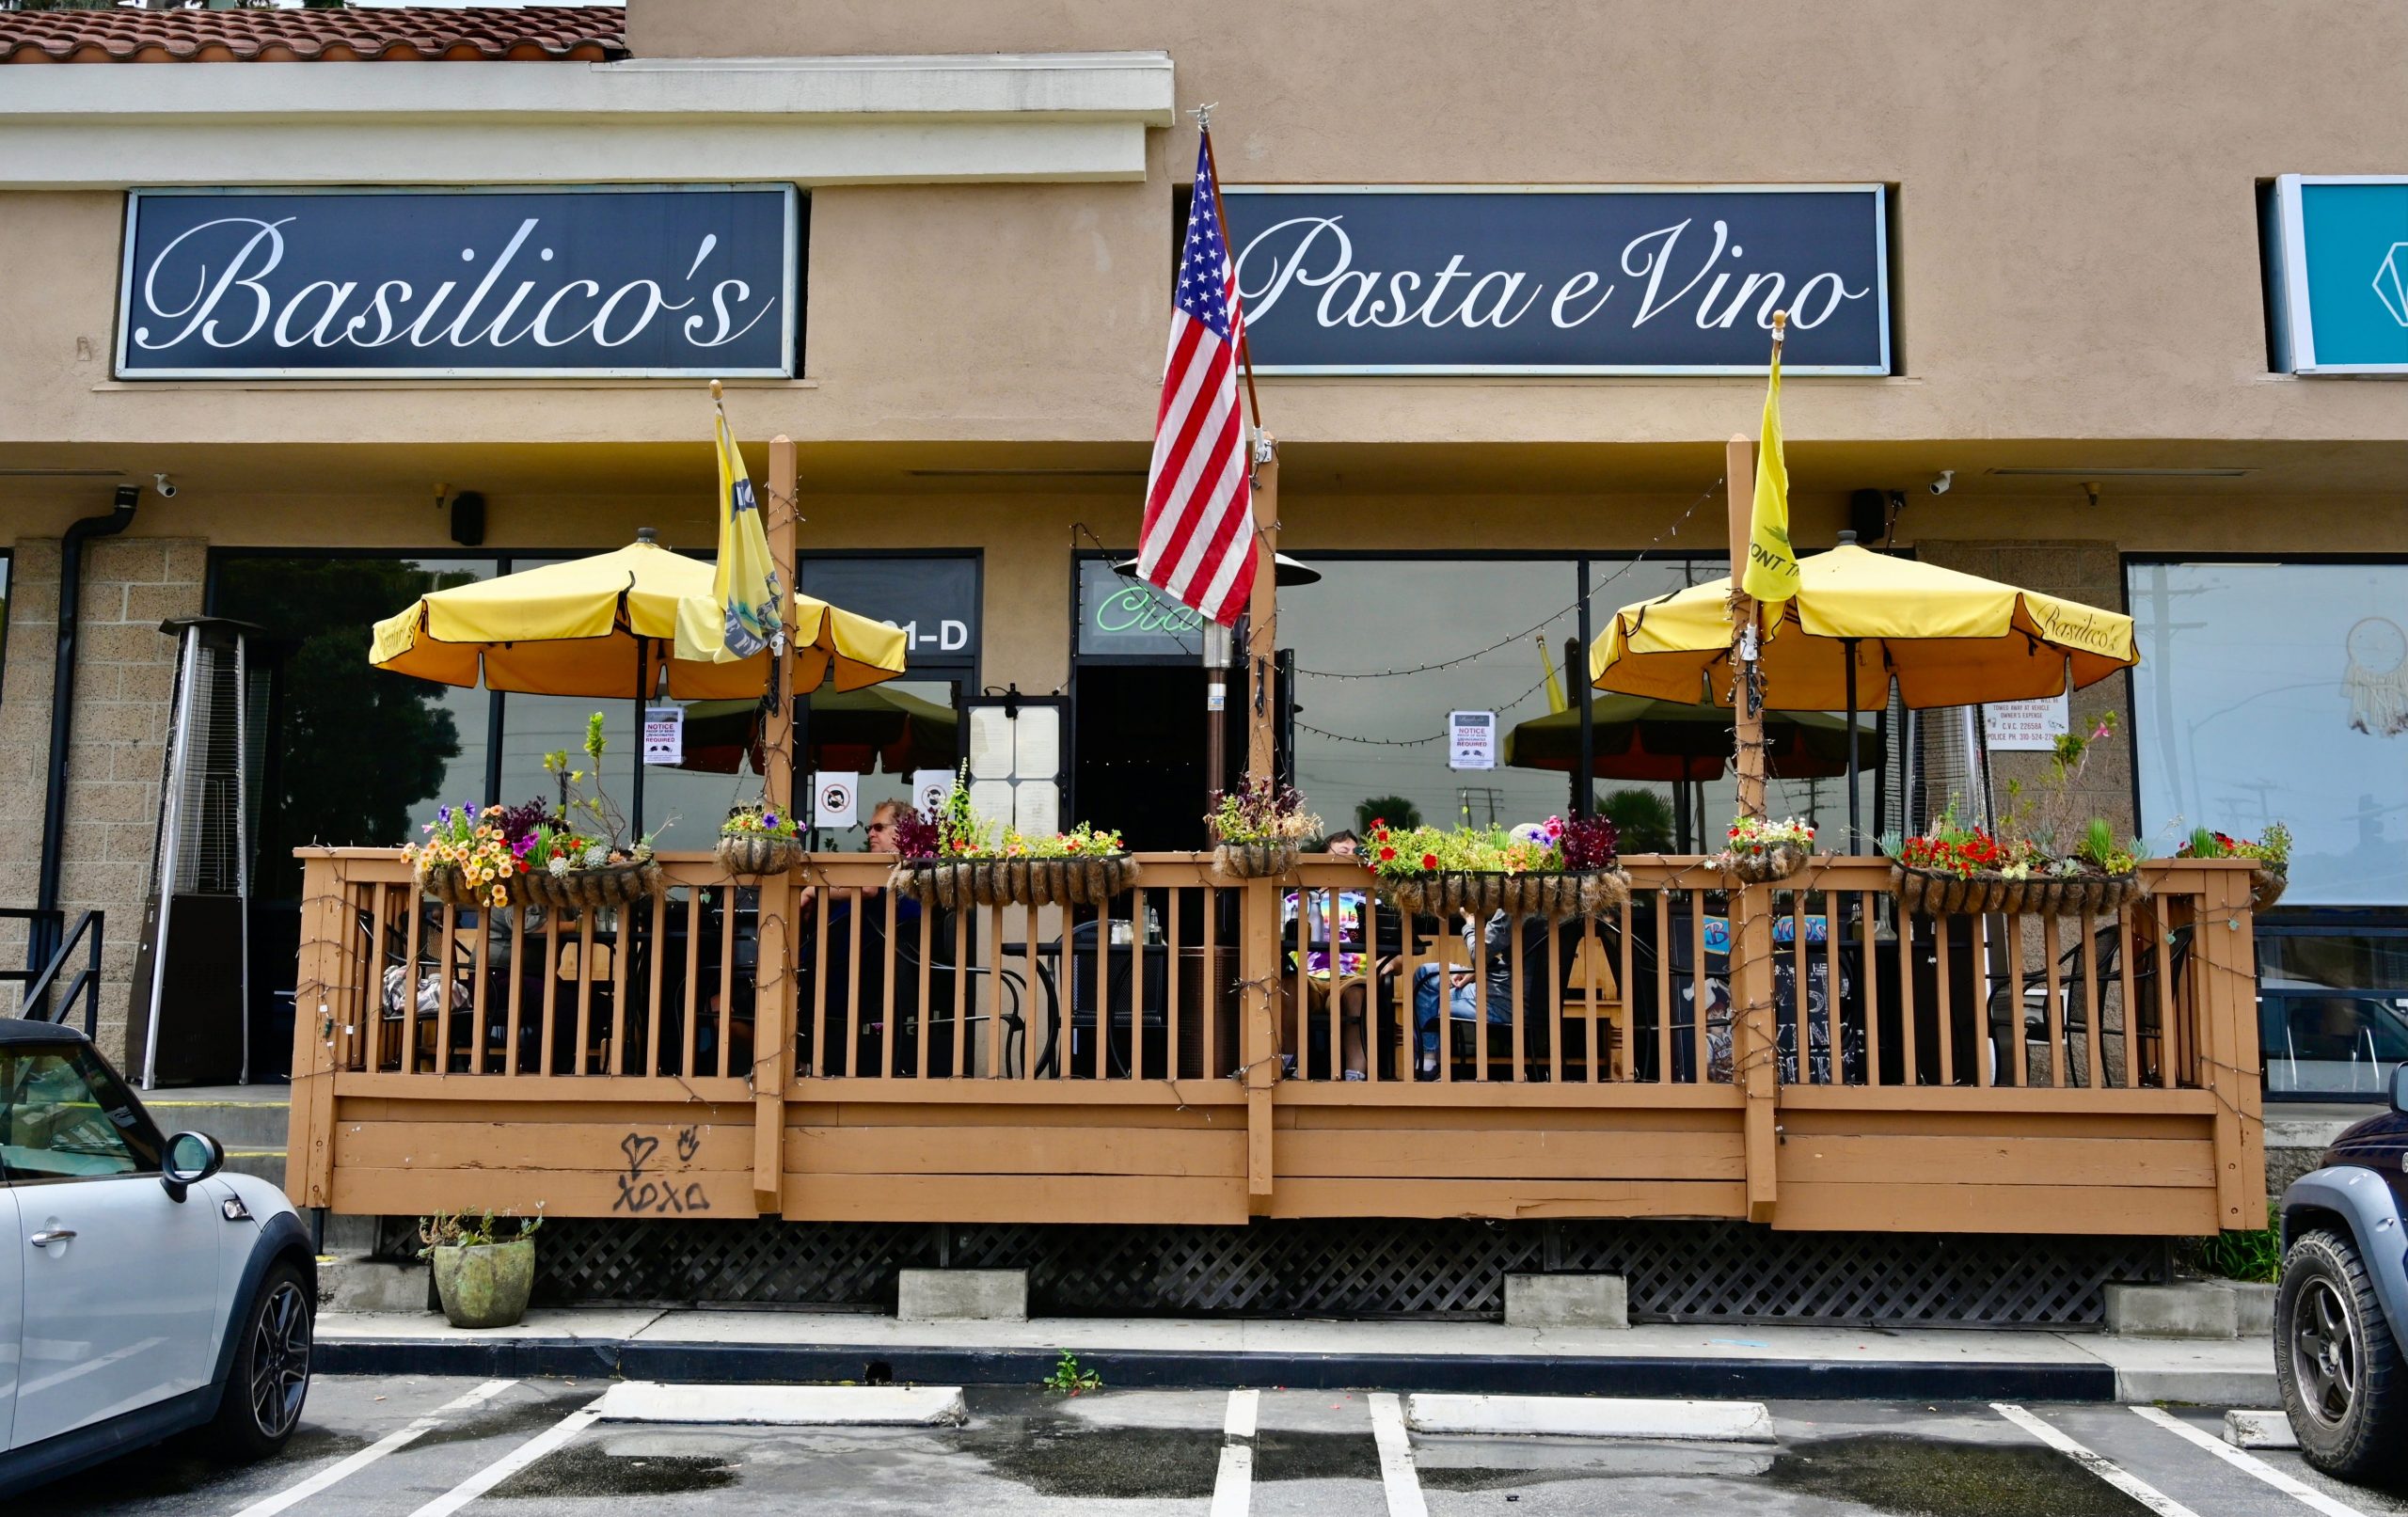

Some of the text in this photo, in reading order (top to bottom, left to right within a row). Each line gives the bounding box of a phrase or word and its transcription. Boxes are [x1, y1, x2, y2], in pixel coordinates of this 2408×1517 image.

[135, 215, 775, 351] Basilico's
[1234, 214, 1870, 330] Pasta e Vino
[1750, 539, 1786, 571] ONT
[1096, 585, 1204, 632] Cia
[880, 619, 969, 651] 1-D
